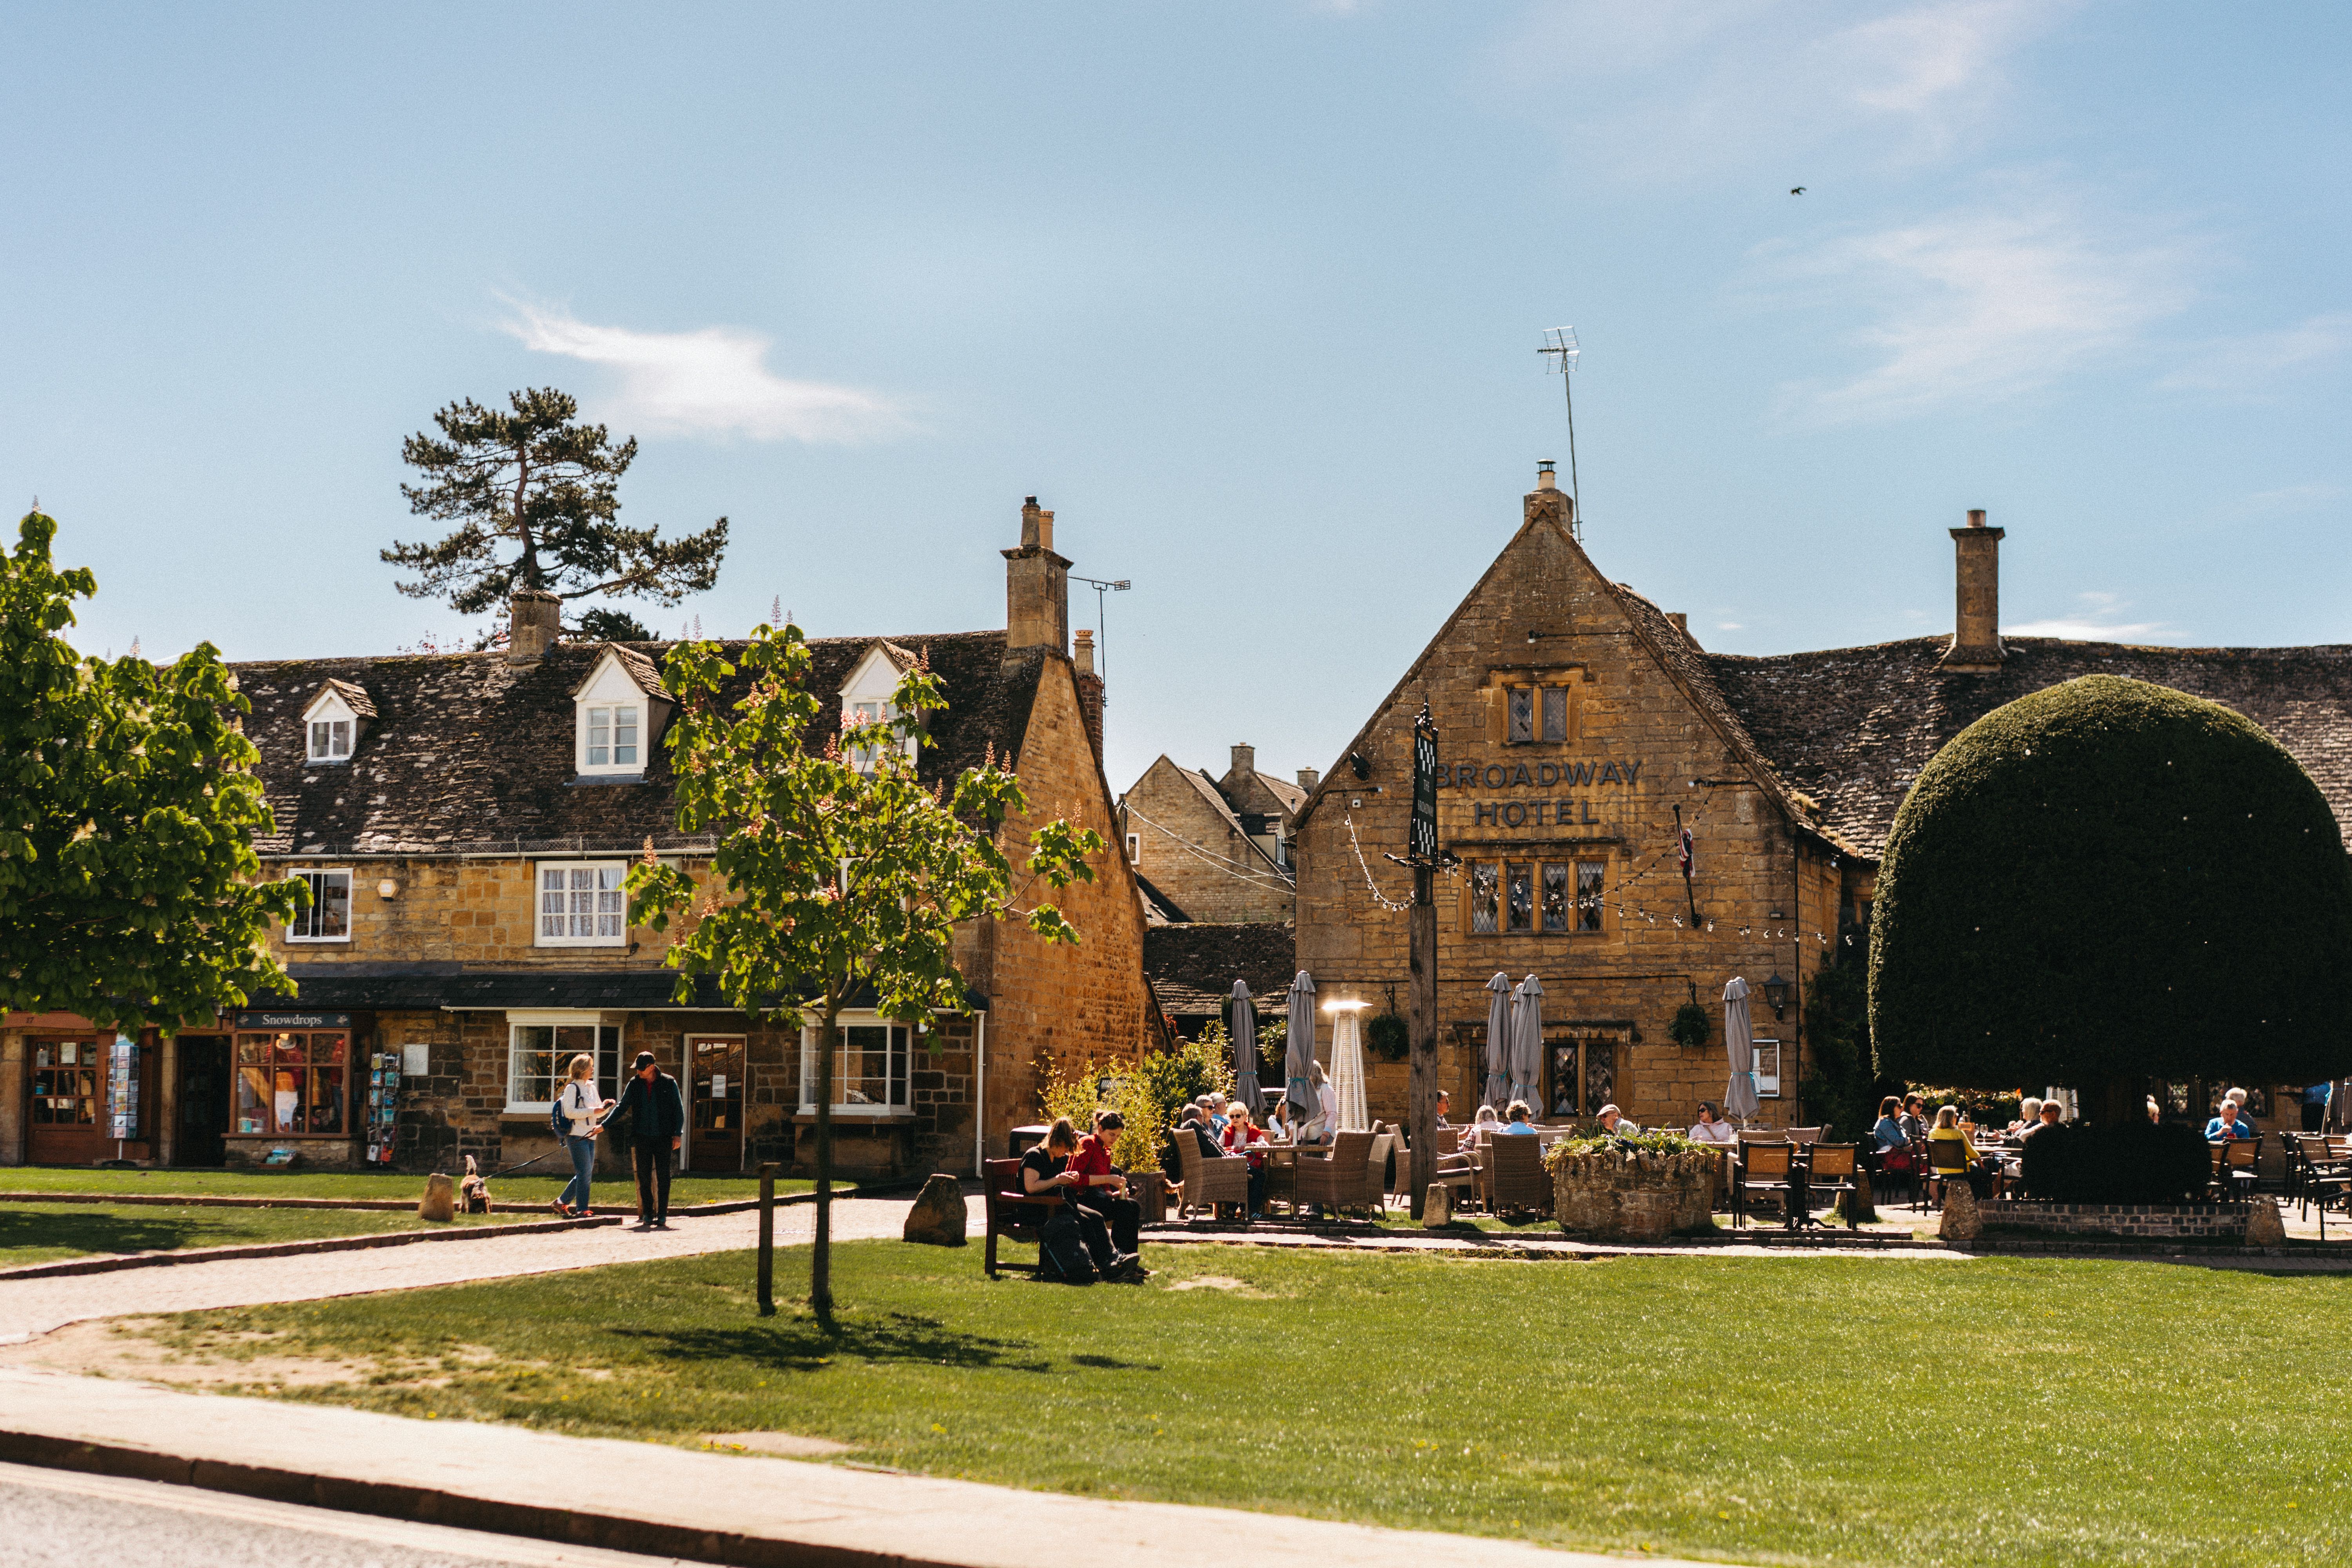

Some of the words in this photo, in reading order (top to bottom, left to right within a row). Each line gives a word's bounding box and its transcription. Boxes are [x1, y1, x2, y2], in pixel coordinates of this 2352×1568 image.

[1437, 760, 1641, 789] BROADWAY
[1475, 800, 1600, 827] HOTEL
[262, 1014, 322, 1027] Snowdrops
